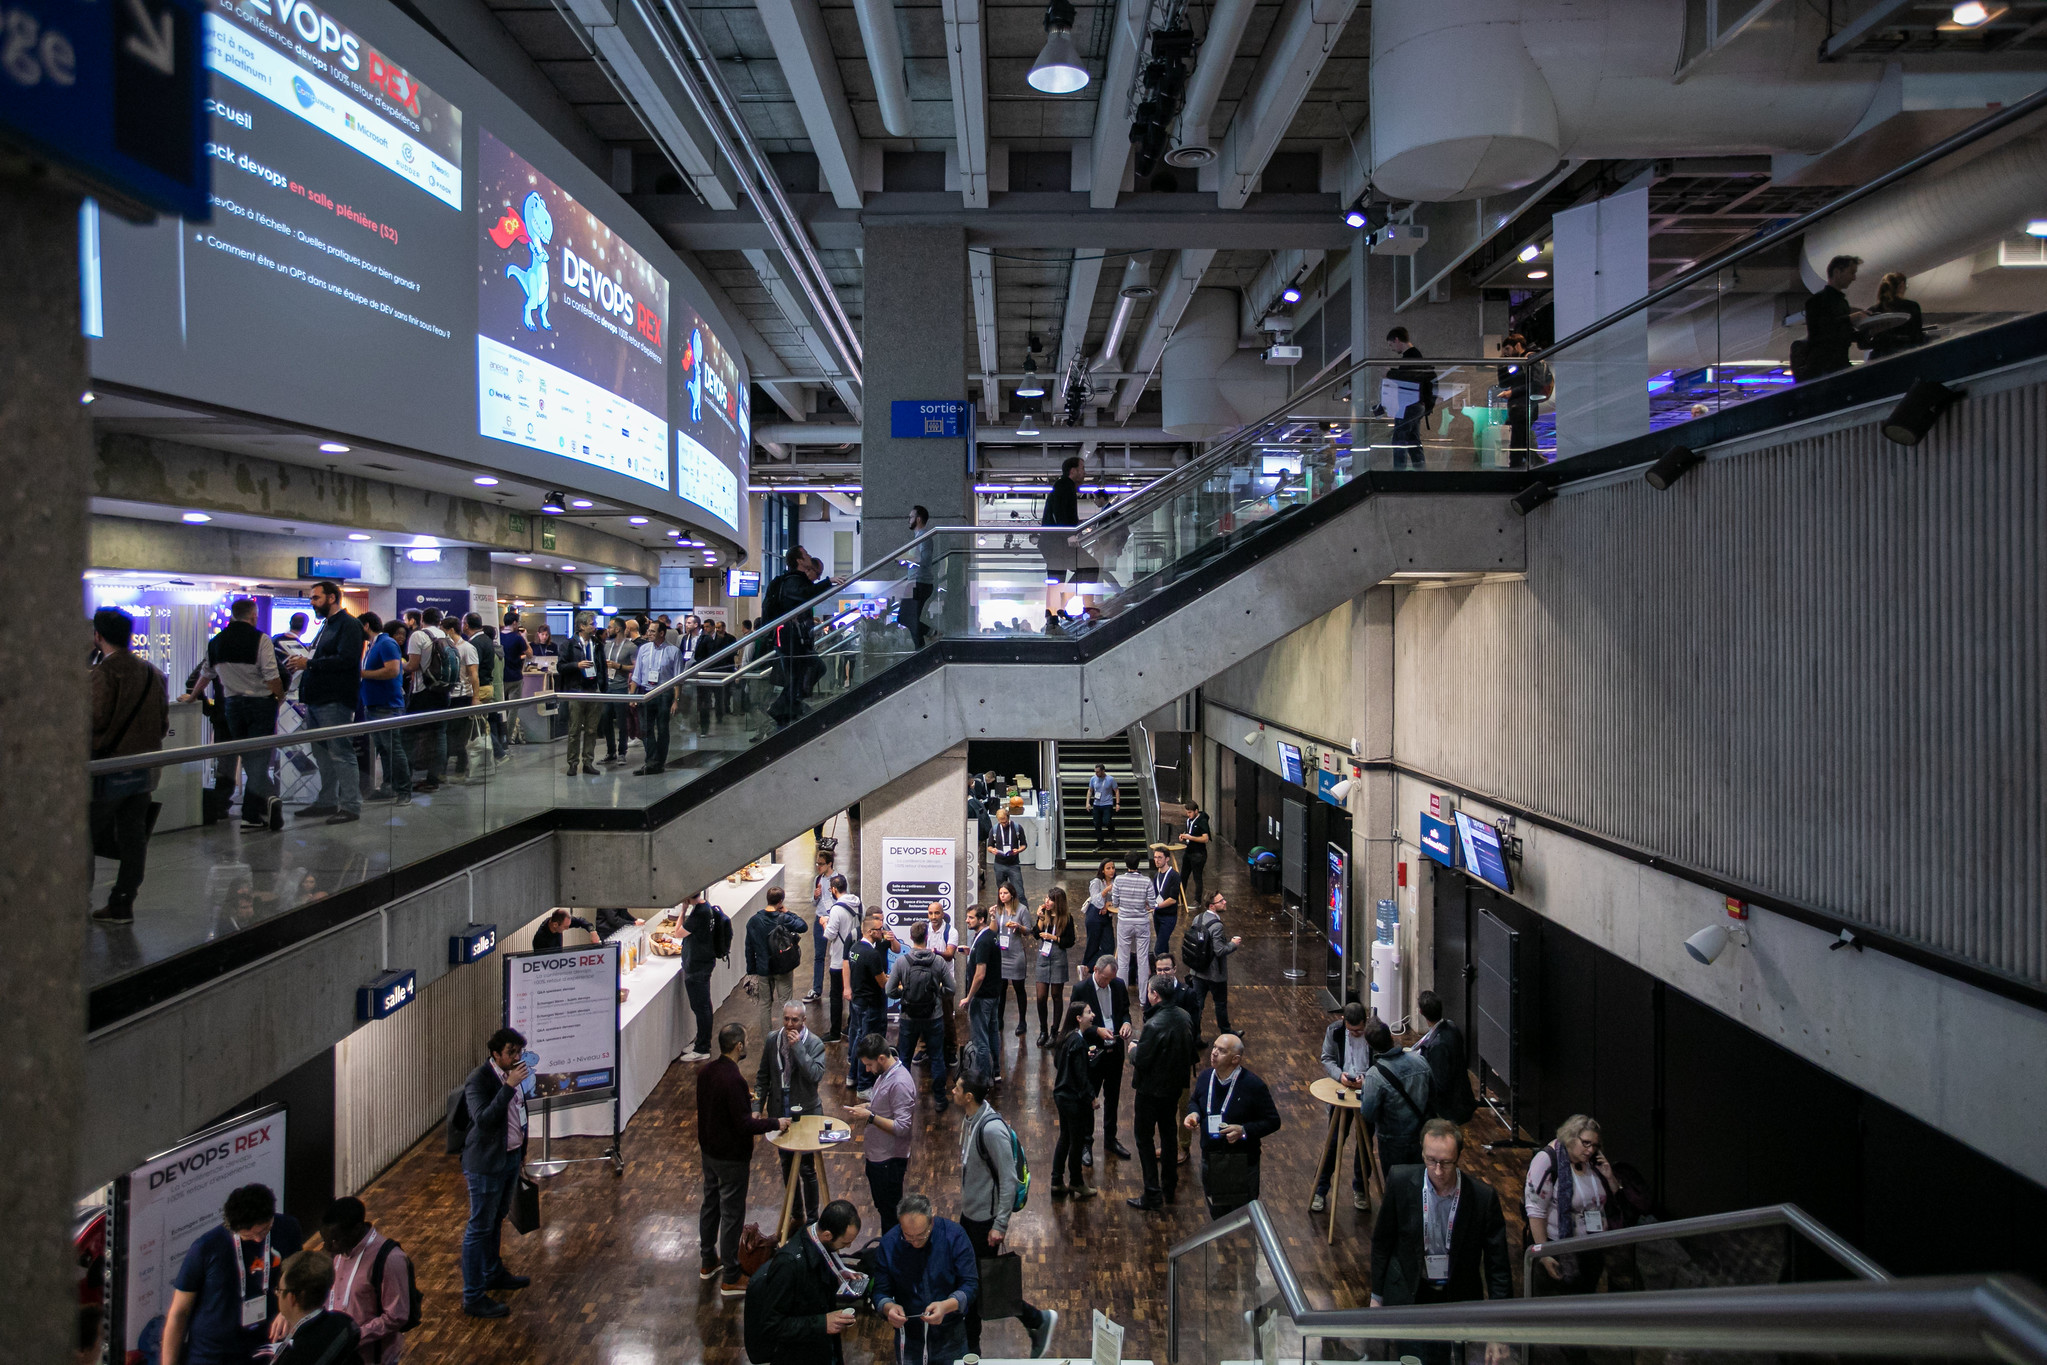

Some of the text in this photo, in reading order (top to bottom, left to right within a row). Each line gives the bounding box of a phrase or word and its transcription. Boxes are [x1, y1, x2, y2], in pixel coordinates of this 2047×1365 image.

[225, 52, 267, 83] platinum
[238, 44, 255, 60] nos
[235, 8, 294, 49] conférence
[294, 44, 328, 71] devops
[330, 65, 350, 87] 100%
[350, 81, 374, 100] retour
[374, 96, 420, 132] d'expérience
[369, 51, 420, 115] REX
[357, 122, 389, 149] Microsoft
[239, 155, 288, 188] devops
[289, 181, 305, 197] en
[308, 189, 334, 210] salle
[336, 203, 378, 232] plénière
[379, 223, 399, 246] (S2)
[247, 208, 254, 220] à
[255, 211, 291, 236] l'échelle
[297, 230, 327, 251] Quelles
[327, 245, 361, 267] pratiques
[361, 260, 377, 274] pour
[378, 266, 393, 281] bien
[393, 274, 416, 291] grandir
[207, 235, 256, 262] Comment
[257, 254, 276, 269] être
[276, 262, 288, 274] un
[289, 266, 307, 281] OPS
[308, 275, 327, 290] dans
[328, 282, 343, 295] une
[343, 288, 369, 306] équipe
[369, 300, 379, 310] de
[380, 302, 394, 315] DEV
[394, 310, 408, 322] sans
[408, 314, 420, 327] finir
[419, 319, 432, 332] sous
[563, 247, 662, 348] DEVOPS REX
[571, 299, 601, 324] conférence
[601, 316, 618, 335] devops
[920, 402, 956, 414] sortie
[890, 847, 947, 856] DEVOPS REX
[472, 931, 495, 956] salle 3
[522, 953, 605, 974] DEVOPS REX
[384, 977, 414, 1010] salle 4
[576, 1055, 600, 1063] Niveau
[150, 1125, 272, 1191] DEVOPS REX
[186, 1182, 208, 1198] retour
